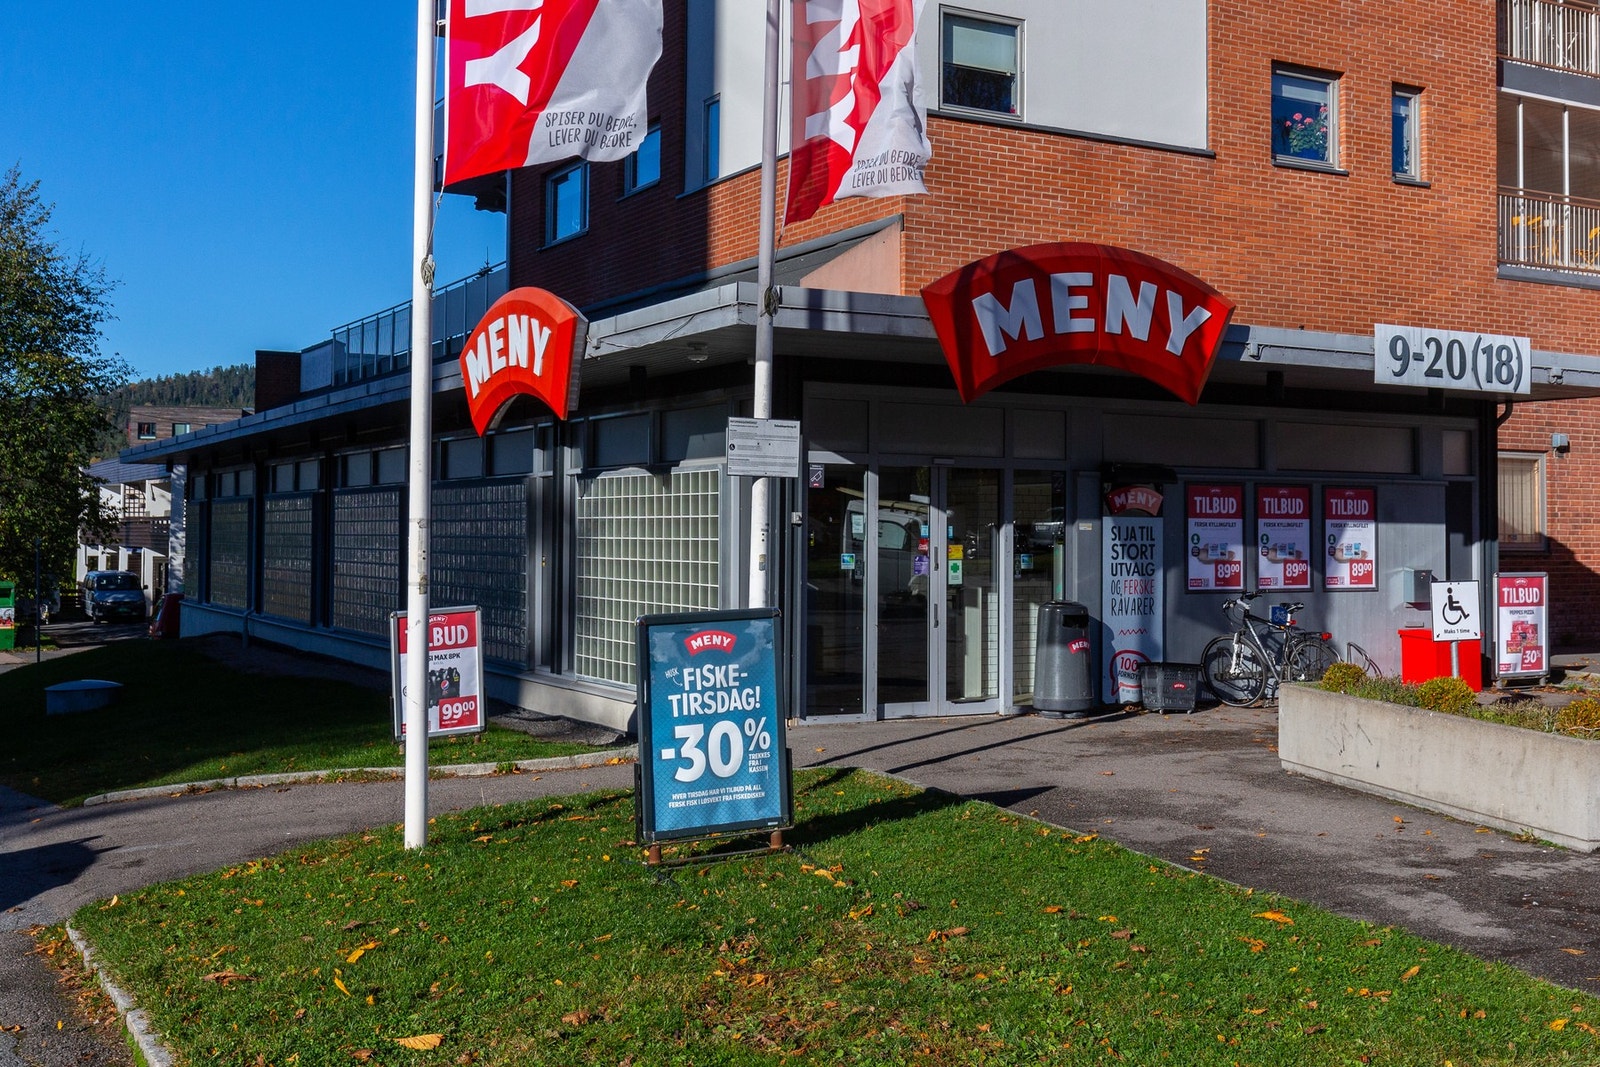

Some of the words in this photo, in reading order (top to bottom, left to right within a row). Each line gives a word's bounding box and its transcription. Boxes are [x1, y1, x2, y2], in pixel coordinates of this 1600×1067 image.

[545, 111, 585, 127] SPISER
[588, 112, 604, 127] DU
[605, 113, 637, 132] BEDRE,
[549, 127, 581, 147] LEVER
[584, 128, 598, 146] DU
[600, 131, 632, 149] BEDRE
[879, 149, 889, 166] DU
[852, 171, 876, 189] LEVER
[877, 168, 888, 184] DU
[890, 166, 919, 183] BEDRE
[971, 271, 1212, 357] MENY
[465, 313, 552, 400] MENY
[1113, 491, 1158, 508] MENY
[1193, 496, 1237, 514] TILBUD
[1263, 497, 1303, 514] TILBUD
[1330, 499, 1369, 515] TILBUD
[1111, 525, 1121, 542] SI
[1124, 525, 1137, 542] JA
[1138, 525, 1155, 542] TIL
[1111, 543, 1155, 560] STORT
[1111, 562, 1155, 577] UTVALG
[1110, 579, 1121, 595] OG
[1123, 578, 1155, 595] FERSKE
[1502, 587, 1540, 604] TILBUD
[1111, 594, 1155, 617] RÅVARER
[690, 635, 731, 650] MENY
[434, 653, 448, 661] MAX
[664, 667, 680, 679] HUSK
[682, 664, 748, 691] FISKE-
[668, 686, 761, 718] TIRSDAG!
[661, 716, 771, 782] -30%
[748, 752, 770, 760] TREKKES
[748, 765, 768, 773] KASSEN
[668, 800, 686, 809] FERSK
[686, 799, 698, 807] FISK
[701, 796, 722, 805] LØSVEKT
[722, 794, 733, 802] FRA
[733, 791, 765, 801] FISKEDISKEN
[688, 790, 708, 798] TIRSDAG
[709, 788, 720, 796] HAR
[726, 786, 744, 794] TILBUD
